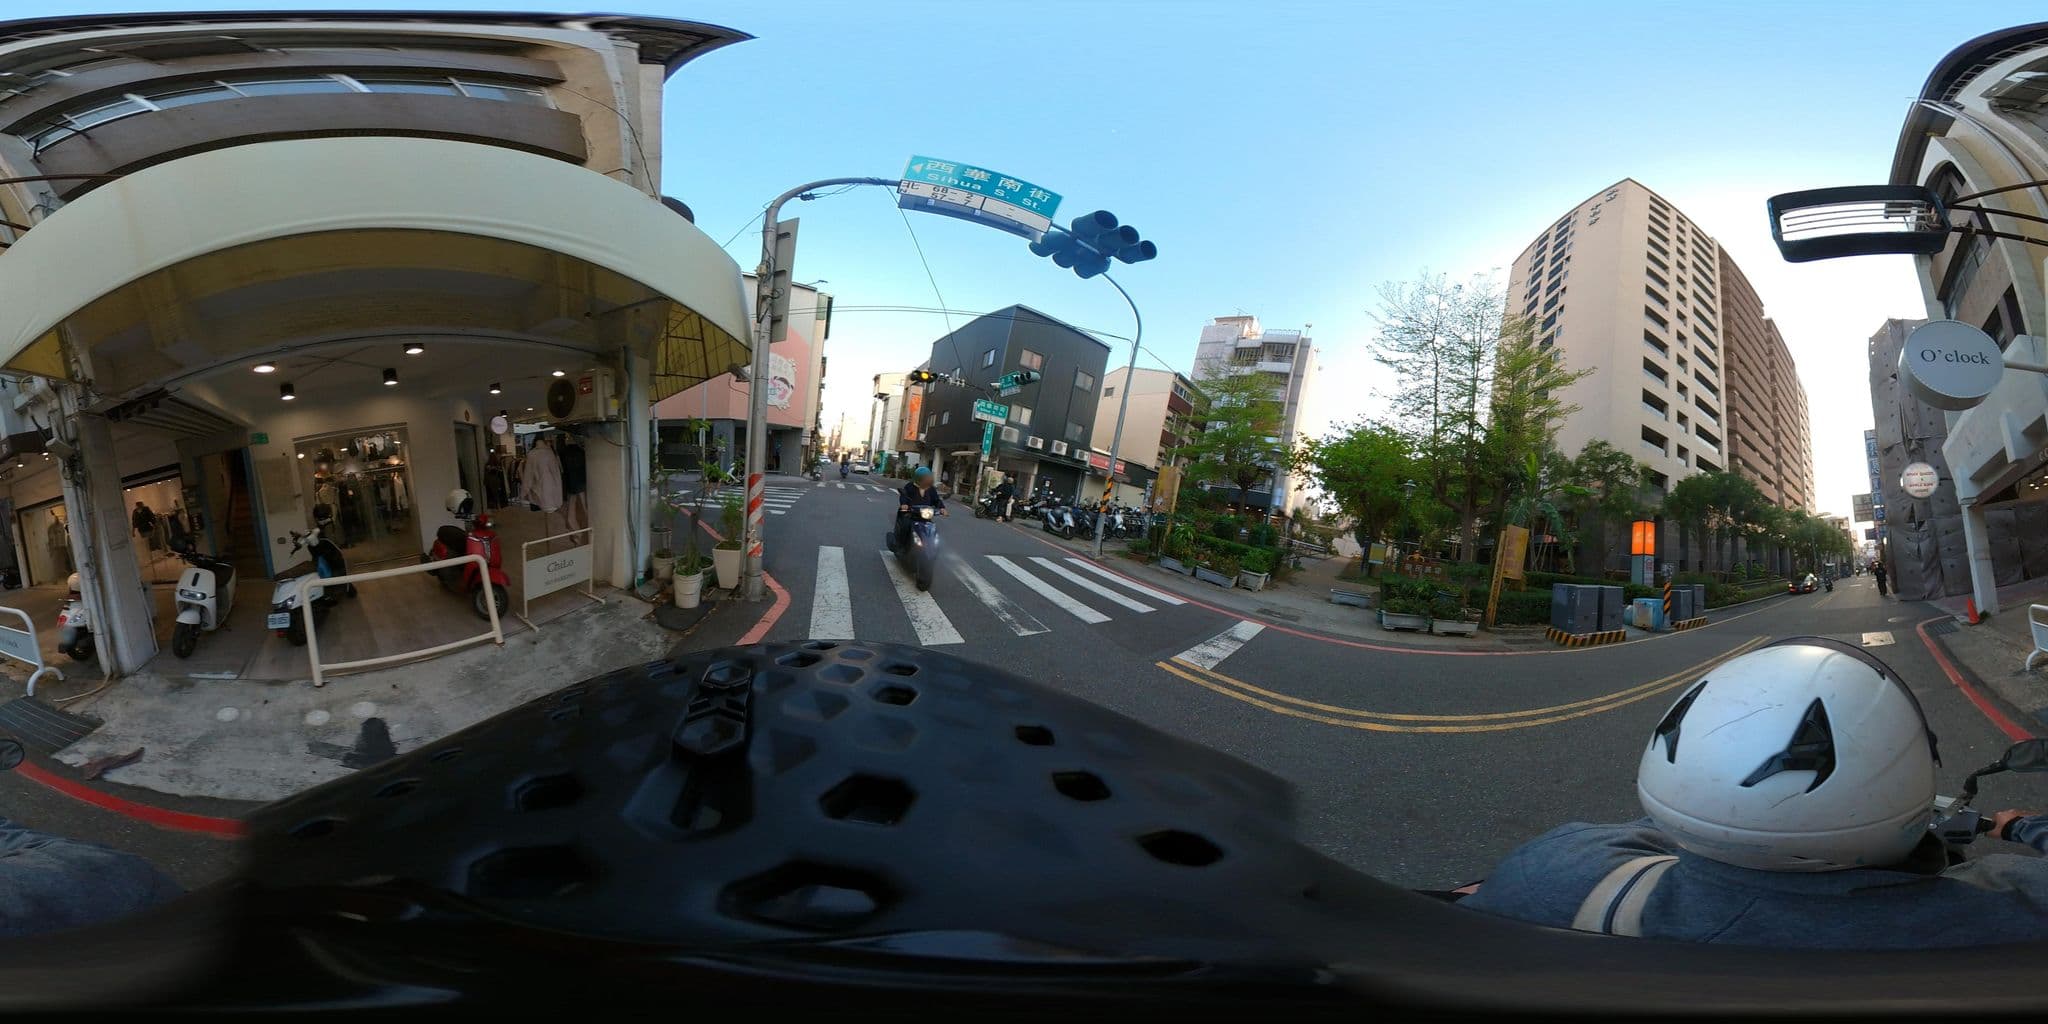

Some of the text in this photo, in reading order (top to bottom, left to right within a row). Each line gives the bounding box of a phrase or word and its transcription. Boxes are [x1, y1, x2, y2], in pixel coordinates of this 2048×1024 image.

[926, 159, 1051, 203] 西華南街
[927, 173, 1041, 211] Sihua S. St.
[1920, 349, 1990, 365] O'clock
